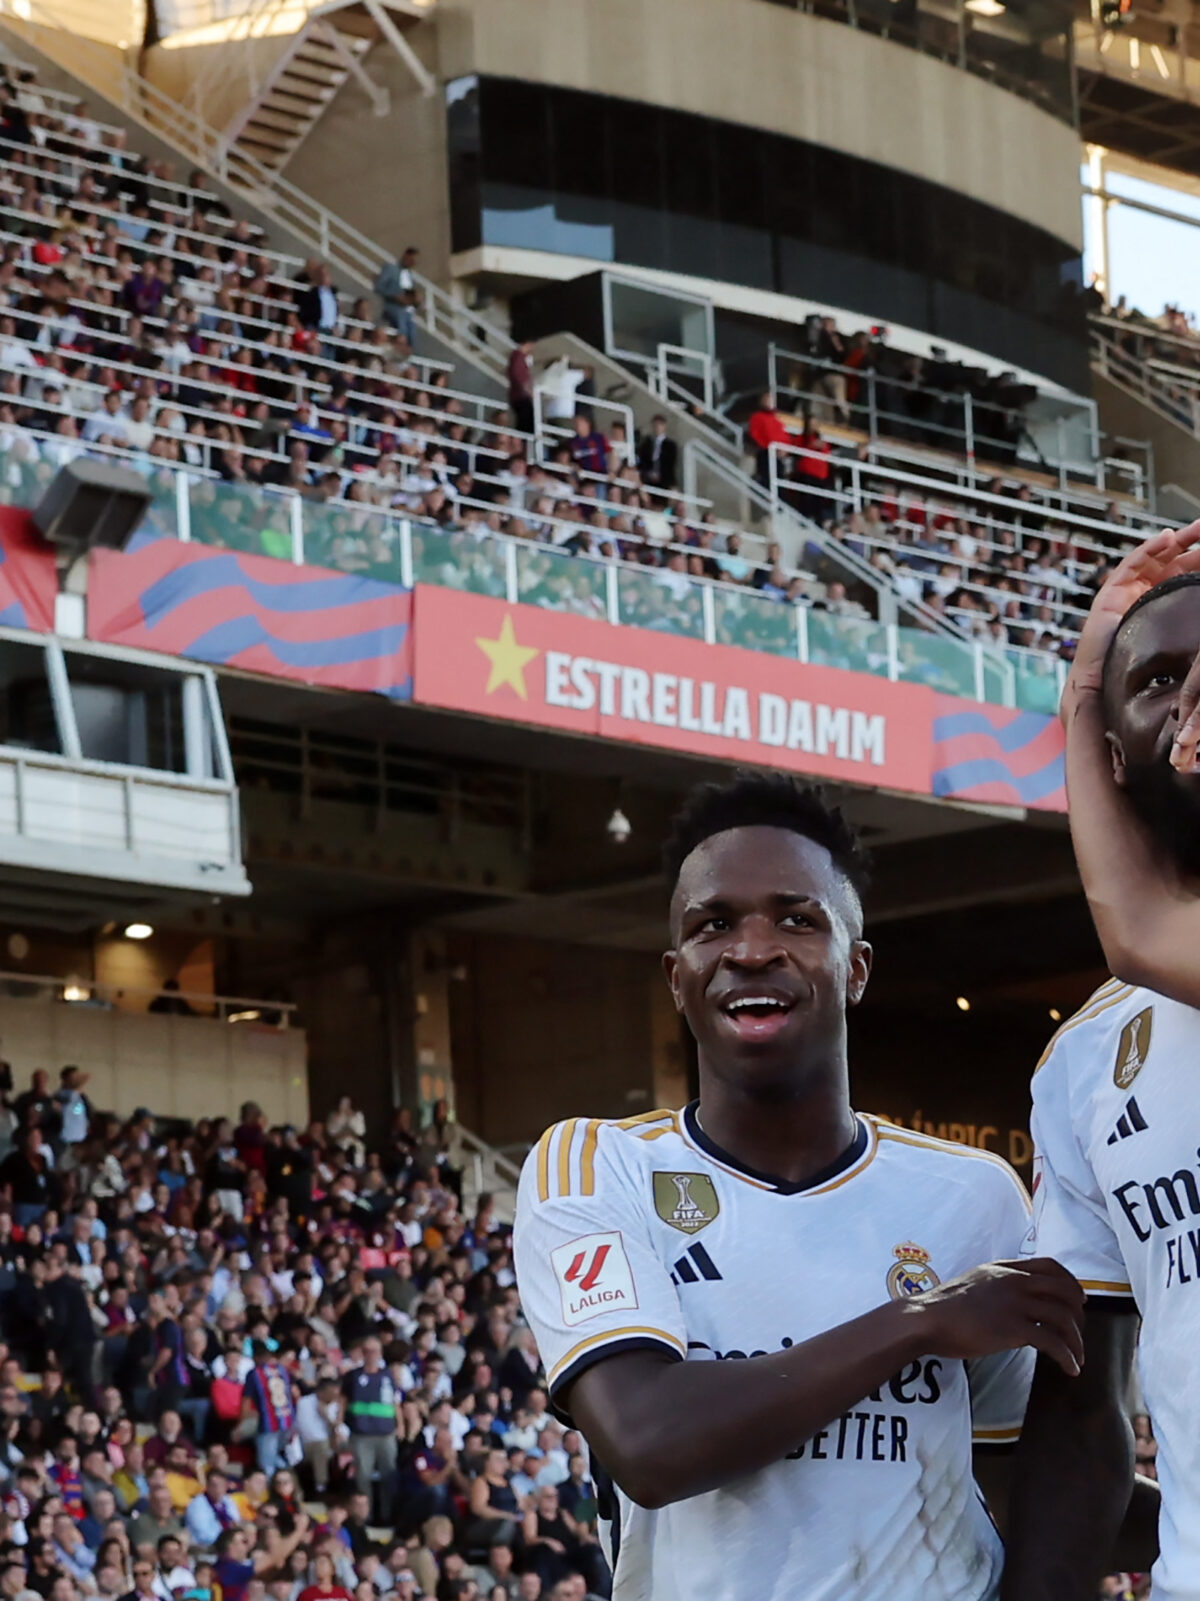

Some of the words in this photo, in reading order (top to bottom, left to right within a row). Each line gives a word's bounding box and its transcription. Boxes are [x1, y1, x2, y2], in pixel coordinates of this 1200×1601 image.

[545, 650, 752, 740] ESTRELLA
[759, 692, 886, 766] DAMM
[672, 1209, 705, 1220] FIFA
[569, 1288, 626, 1314] LALIGA
